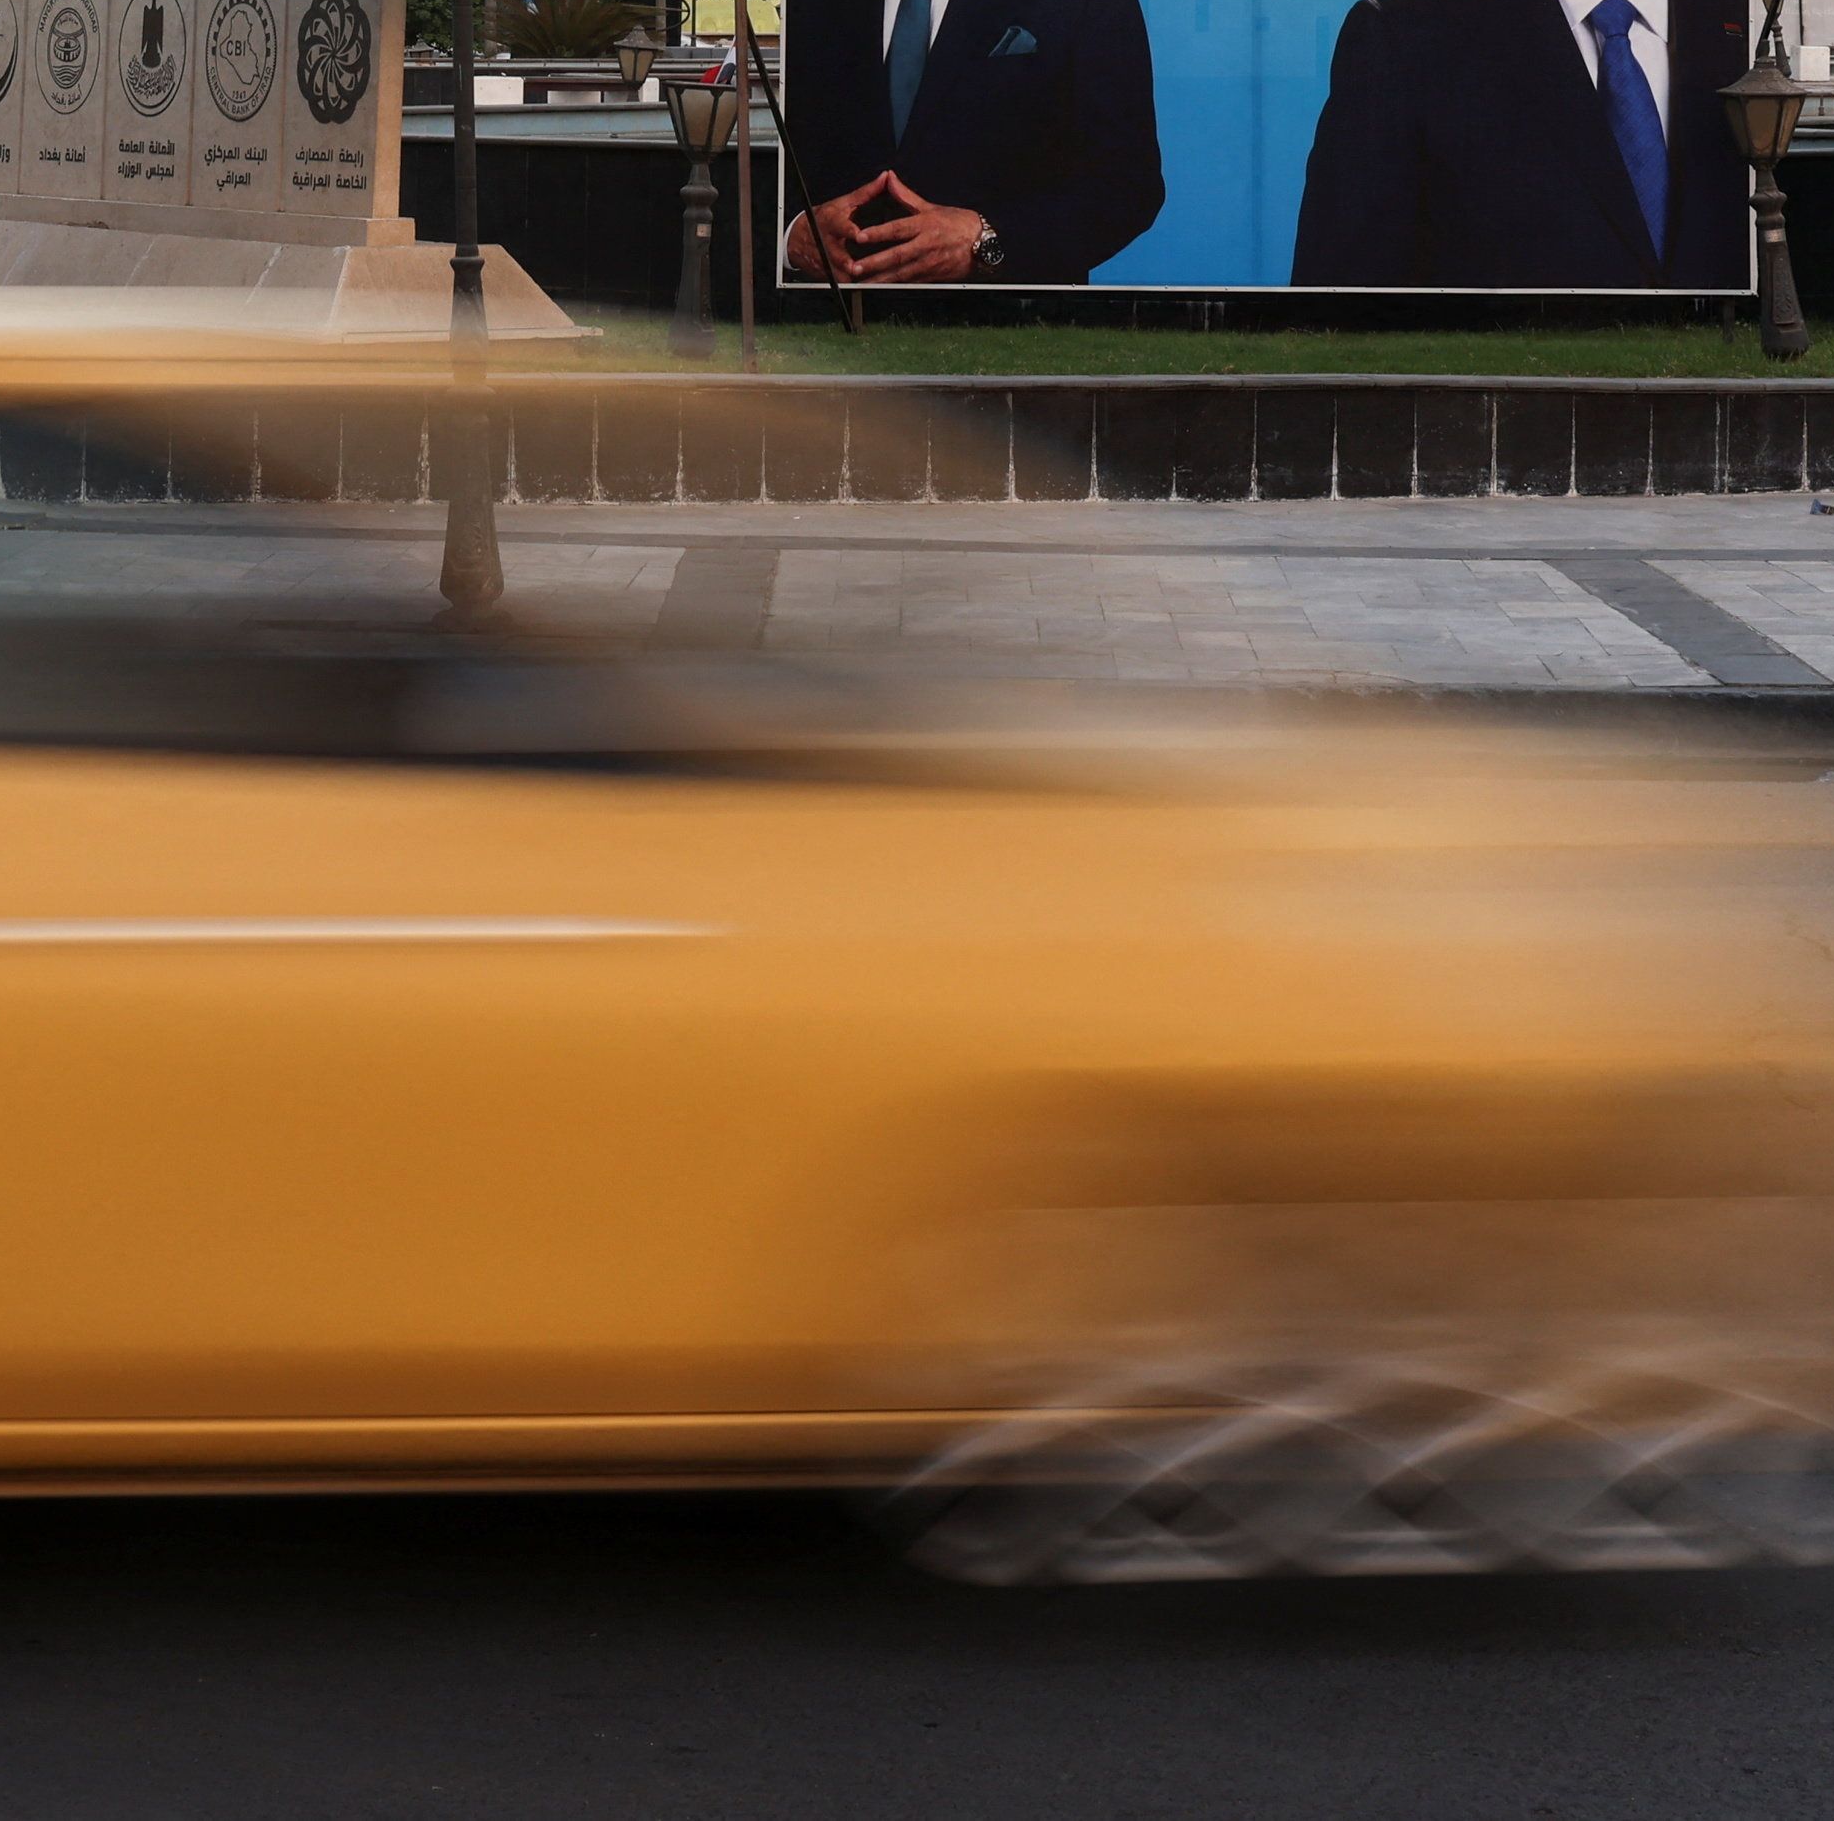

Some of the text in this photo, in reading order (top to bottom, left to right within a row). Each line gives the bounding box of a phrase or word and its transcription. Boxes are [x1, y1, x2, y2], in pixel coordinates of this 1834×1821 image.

[226, 40, 246, 57] CBI
[210, 66, 230, 112] CENTRAL
[231, 102, 251, 115] BANK
[39, 145, 86, 166] أمانة بغداد
[119, 138, 175, 156] الأمانة العامة
[204, 144, 268, 166] البنك المركزي
[295, 146, 364, 168] رابطة المصارف
[118, 160, 175, 181] لمجلس الوزراء
[216, 170, 251, 191] العراقي
[292, 171, 367, 192] الخاصة العراقية
